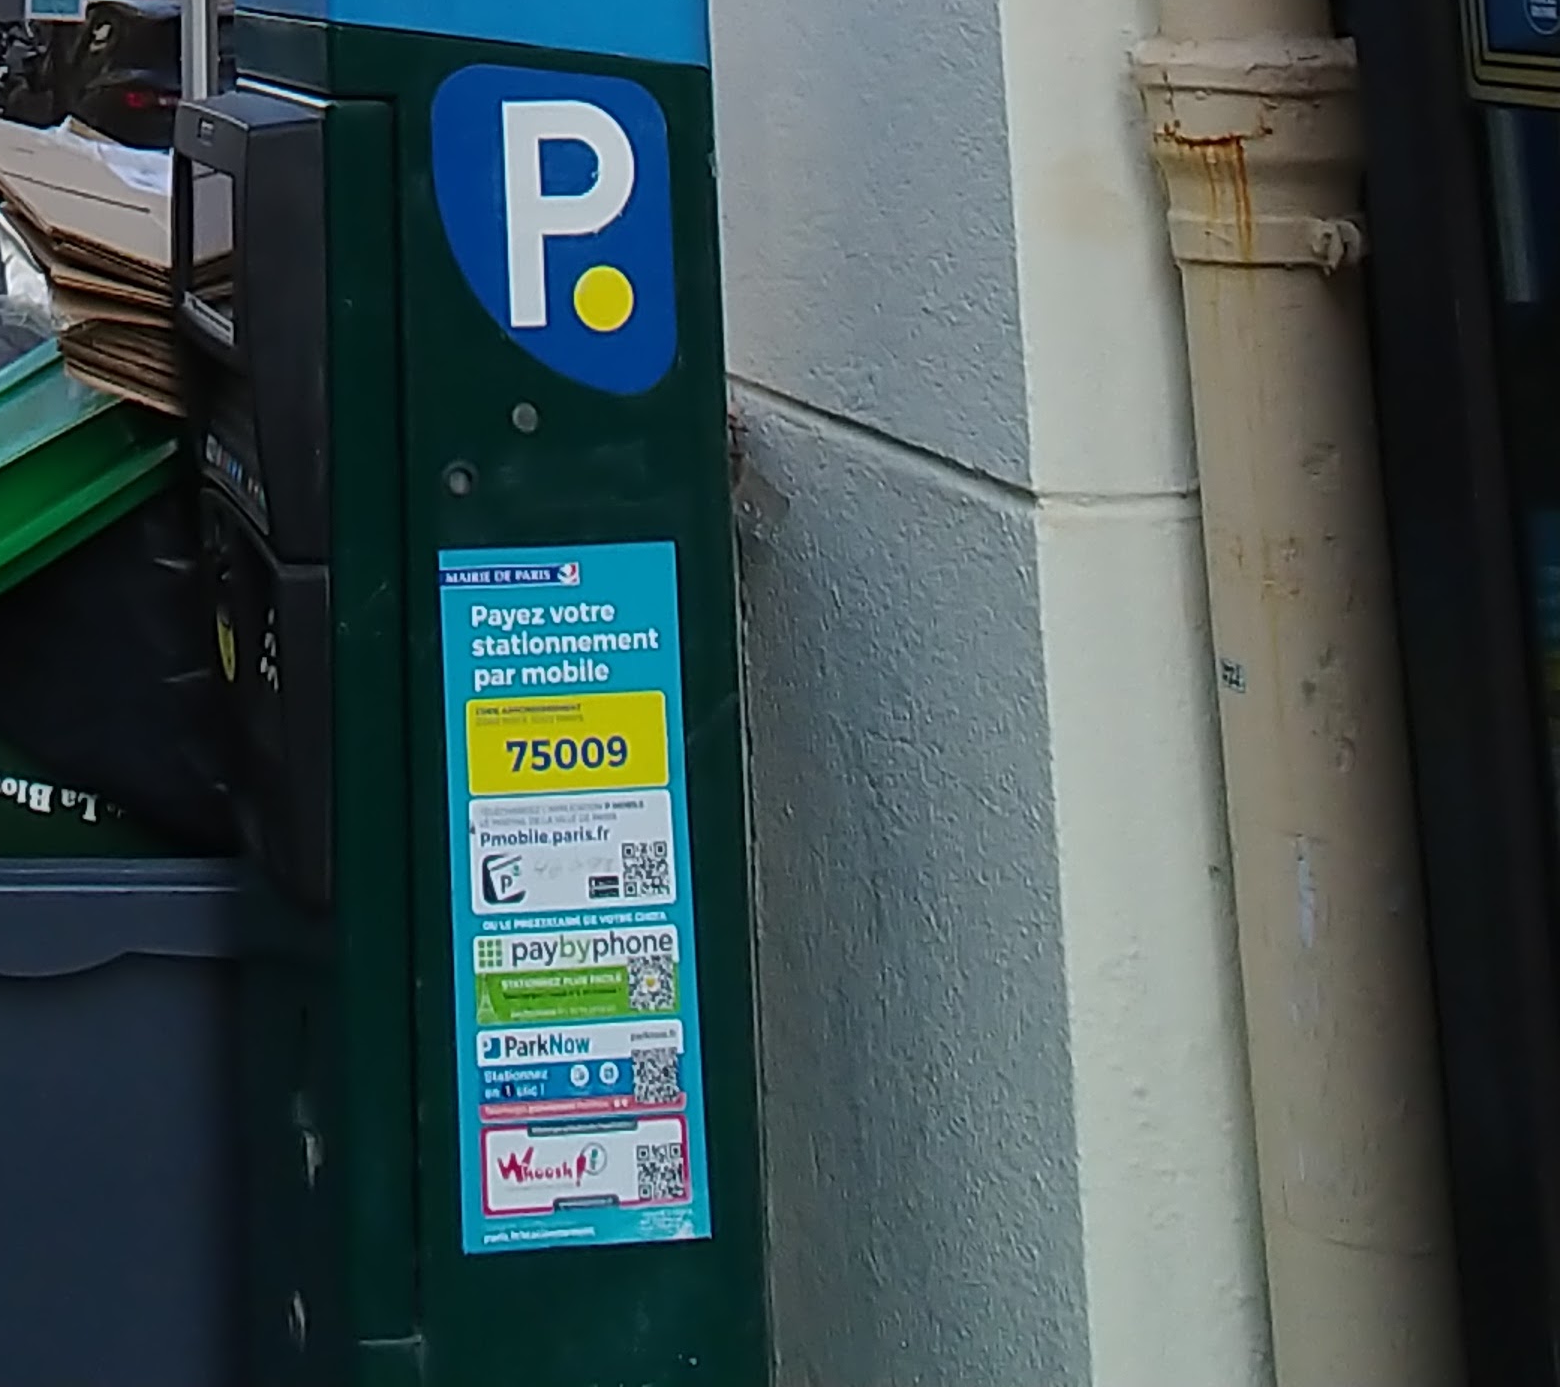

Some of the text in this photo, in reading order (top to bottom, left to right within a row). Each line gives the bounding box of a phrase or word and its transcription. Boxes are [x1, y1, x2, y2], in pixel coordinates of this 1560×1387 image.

[502, 100, 635, 327] P
[445, 569, 551, 583] MAIRIE DE PARIS
[471, 601, 615, 629] Payez votre
[472, 628, 659, 657] stationnement
[474, 659, 609, 692] par mobile
[506, 735, 628, 772] 75009
[61, 787, 99, 822] La
[480, 825, 610, 847] Pmobile.paris.fr
[512, 929, 673, 966] paybyphone
[505, 1033, 590, 1057] ParkNow
